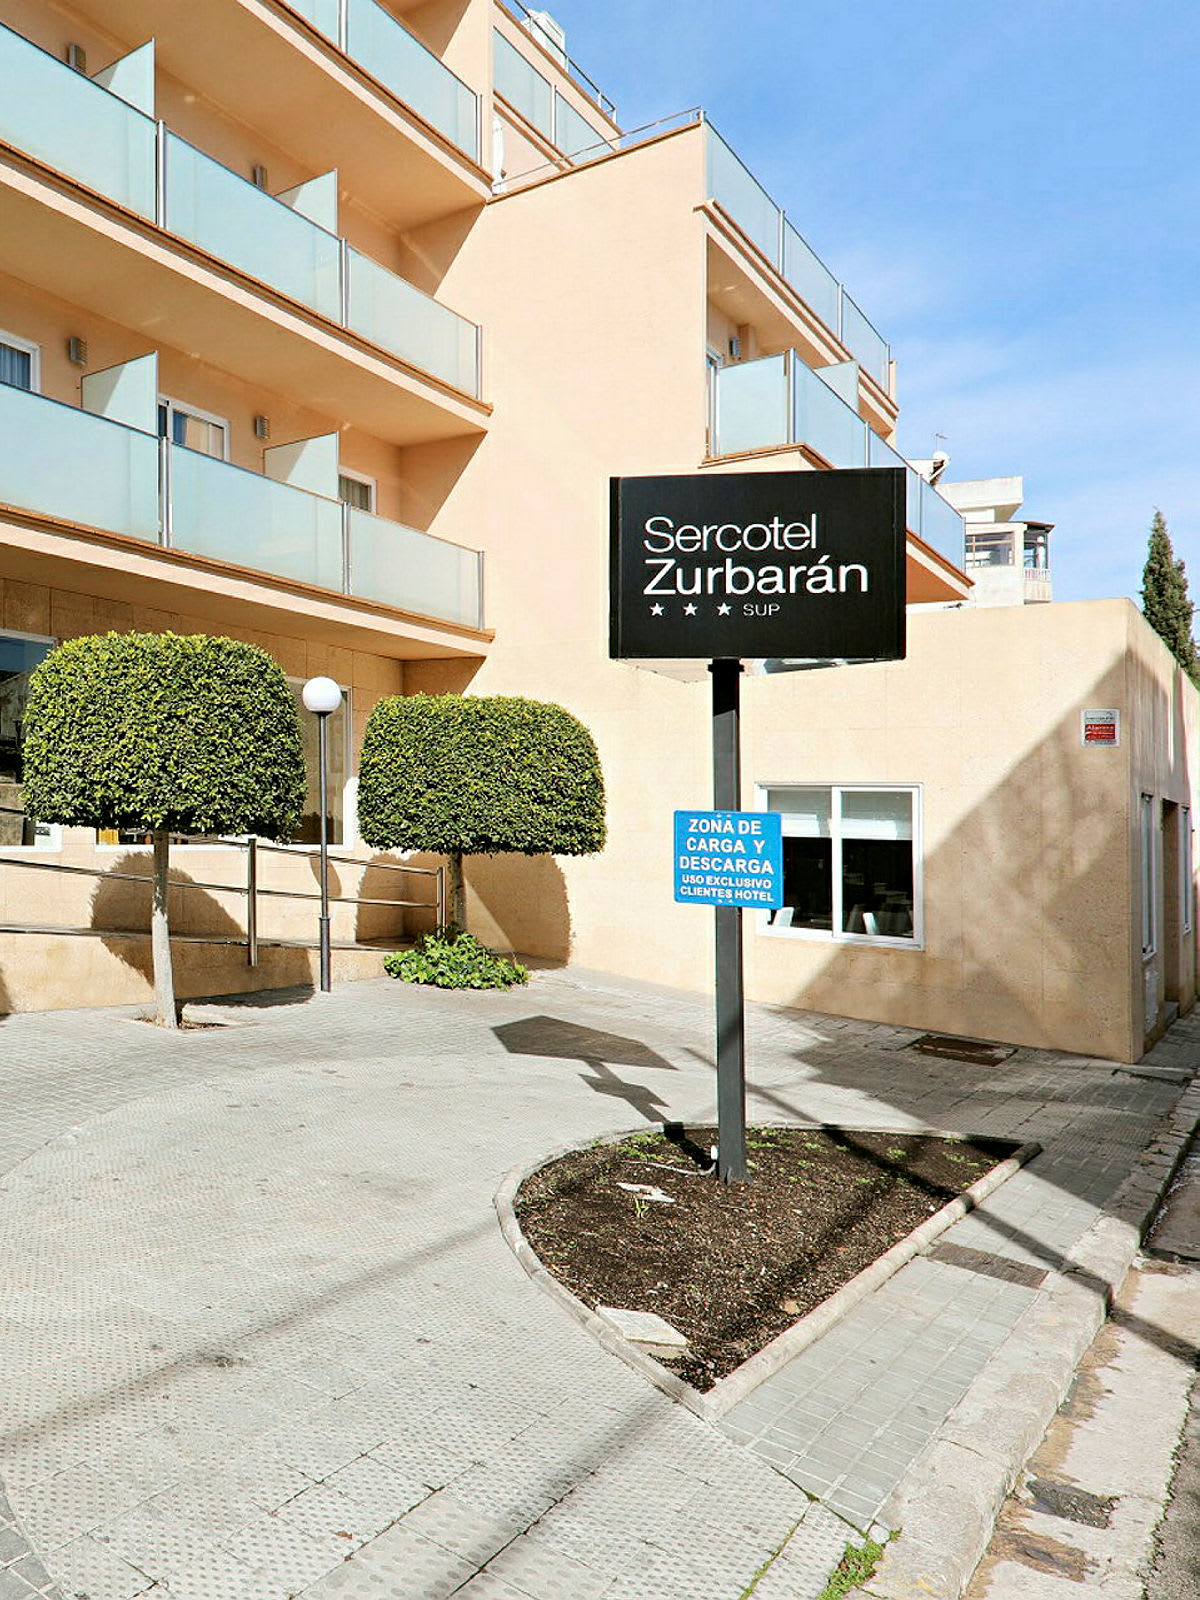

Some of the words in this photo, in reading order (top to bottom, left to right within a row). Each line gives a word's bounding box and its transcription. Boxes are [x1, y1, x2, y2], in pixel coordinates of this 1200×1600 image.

[643, 513, 817, 553] Sercotel
[643, 555, 869, 596] Zurbarán
[743, 603, 780, 616] SUP
[688, 819, 735, 834] ZONA
[738, 820, 763, 835] DE
[686, 837, 747, 854] CARGA
[753, 839, 766, 854] Y
[679, 856, 775, 875] DESCARGA
[681, 874, 705, 885] USO
[706, 875, 772, 889] EXCLUSIVO
[680, 885, 733, 899] CLIENTES
[735, 890, 775, 902] HOTEL
